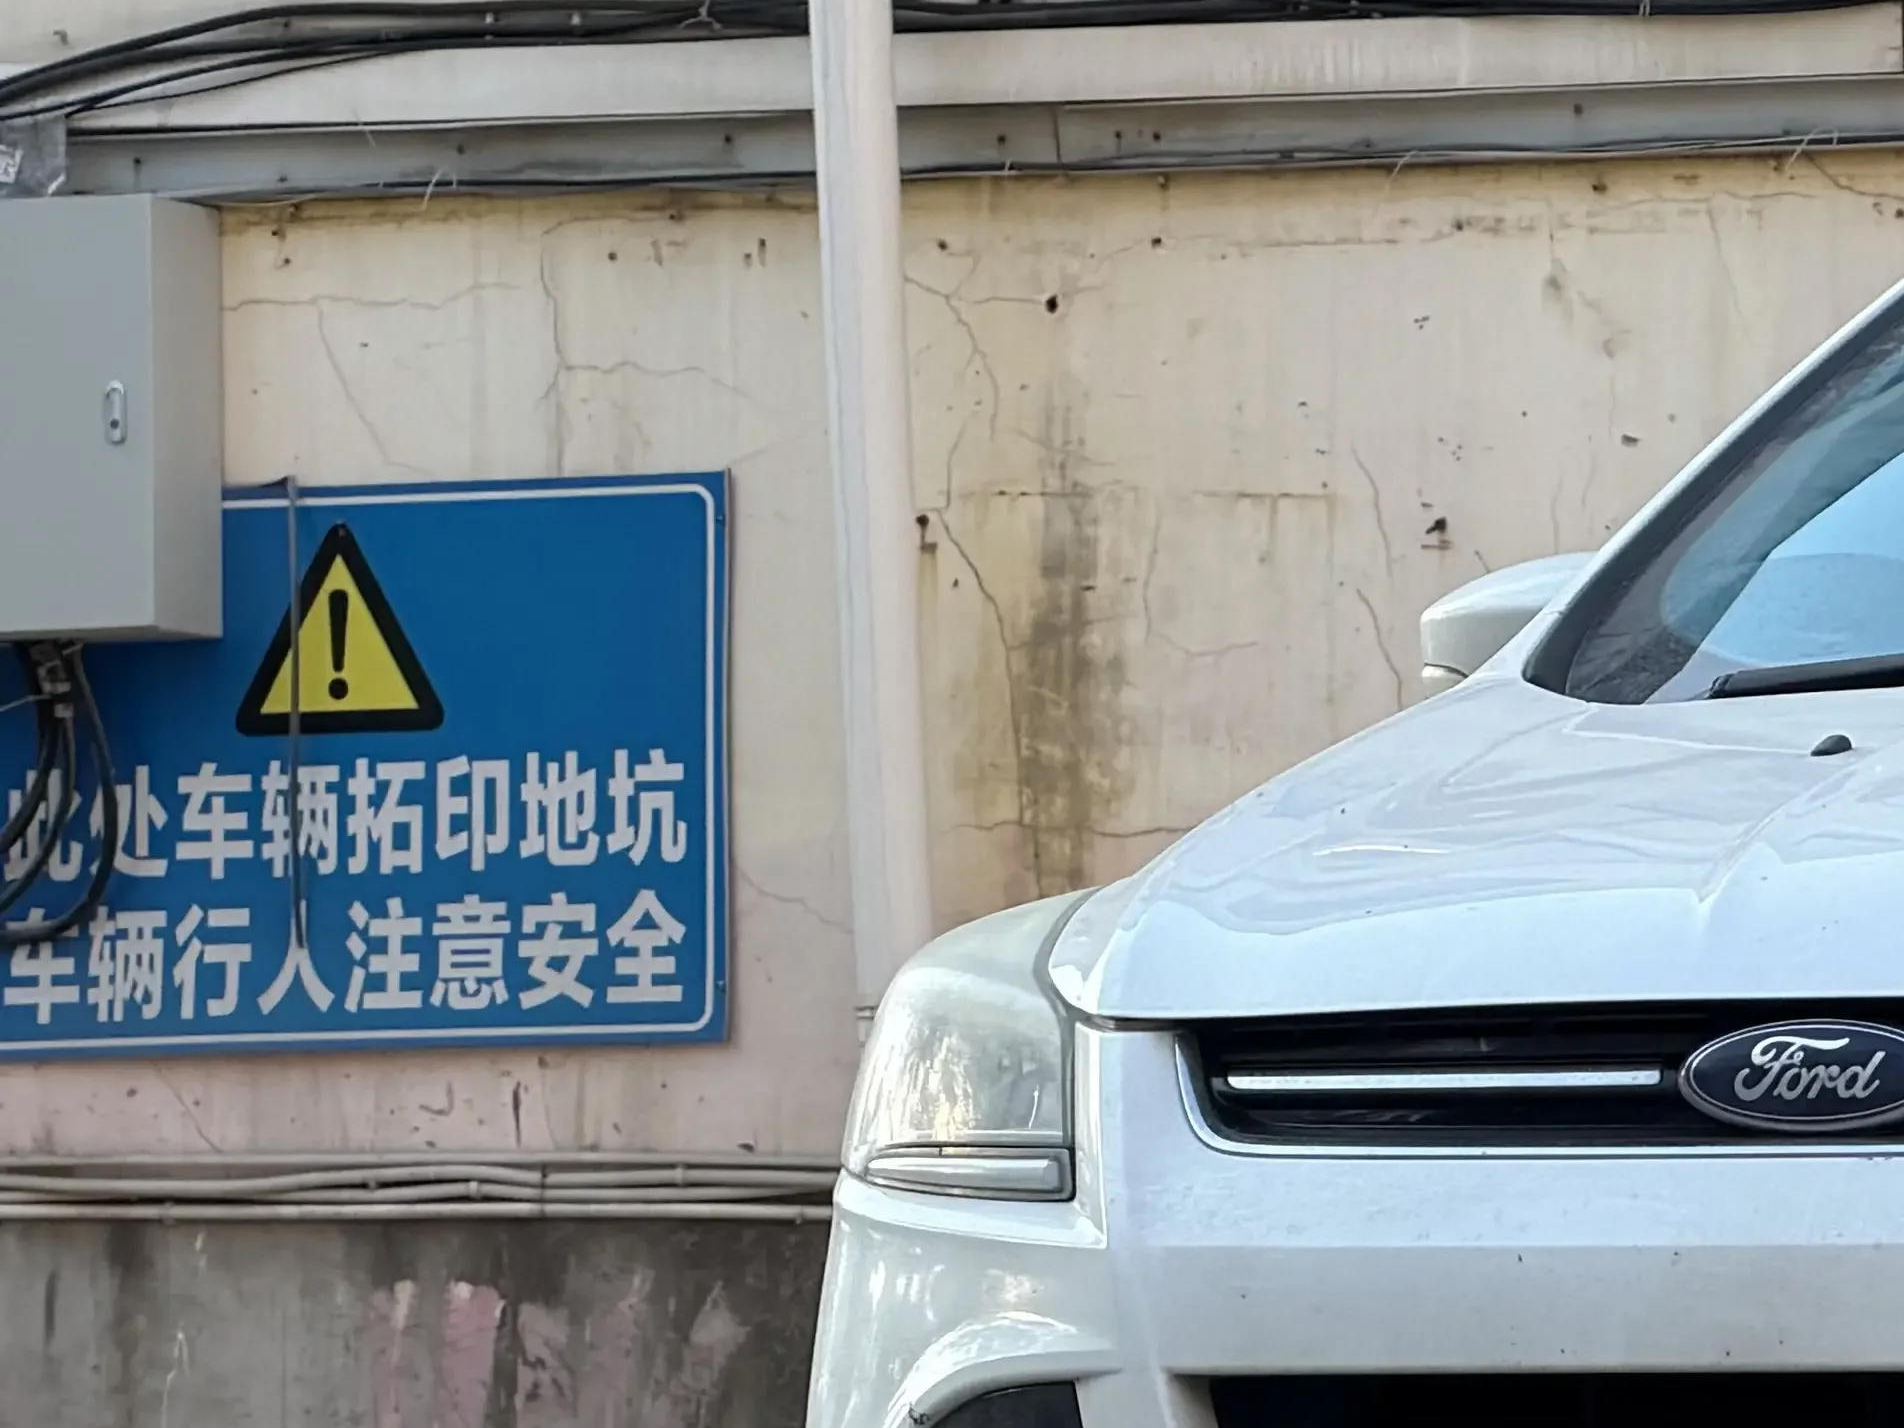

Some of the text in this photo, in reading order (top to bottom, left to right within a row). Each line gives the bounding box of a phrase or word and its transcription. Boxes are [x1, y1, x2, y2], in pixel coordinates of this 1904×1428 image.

[3, 888, 686, 1024] 车辆行人注意安全
[1734, 1035, 1886, 1102] Ford
